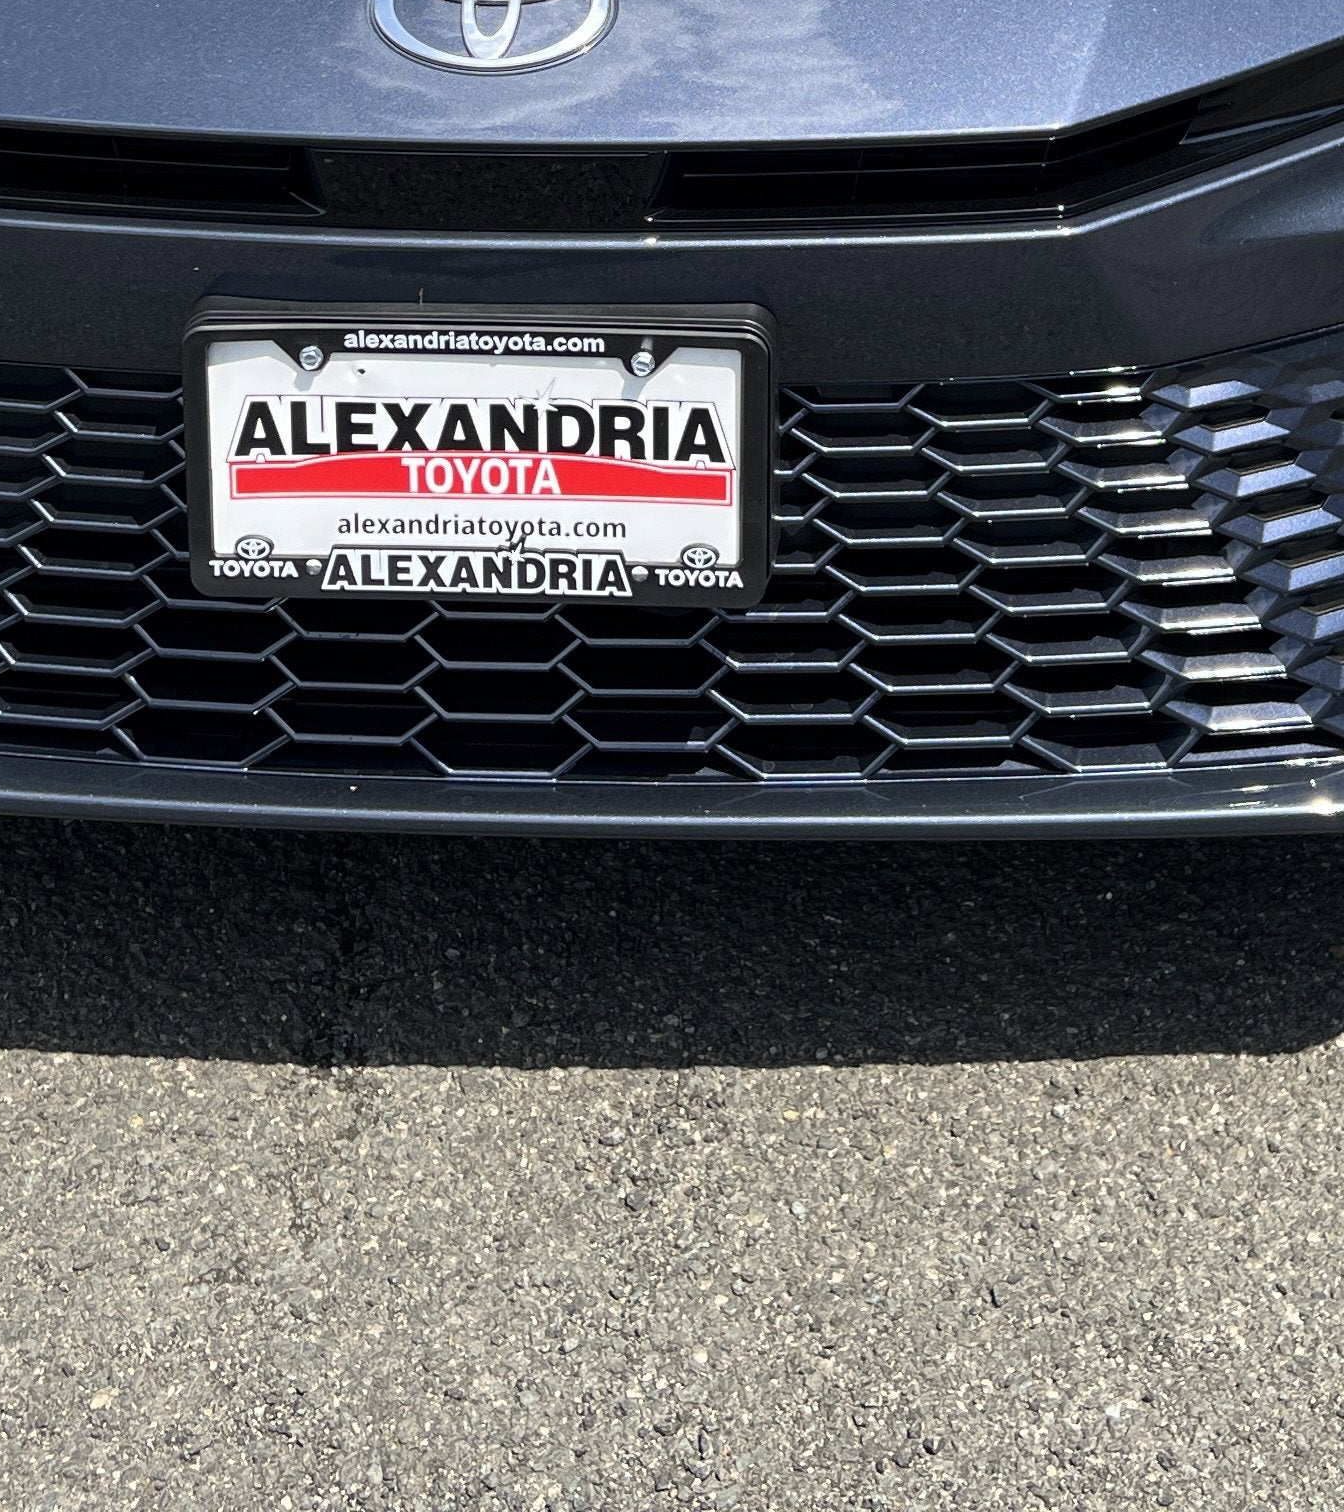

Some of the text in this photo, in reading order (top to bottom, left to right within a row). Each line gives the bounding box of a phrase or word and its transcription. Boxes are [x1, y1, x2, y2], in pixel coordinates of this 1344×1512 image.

[343, 329, 606, 355] alexandriatoyota.com
[232, 399, 730, 466] ALEXANDRIA
[401, 457, 562, 496] TOYOTA
[337, 512, 628, 541] alexandriatoyota.com
[208, 550, 744, 595] TOYOTA ALEXANDRIA TOYOTA
